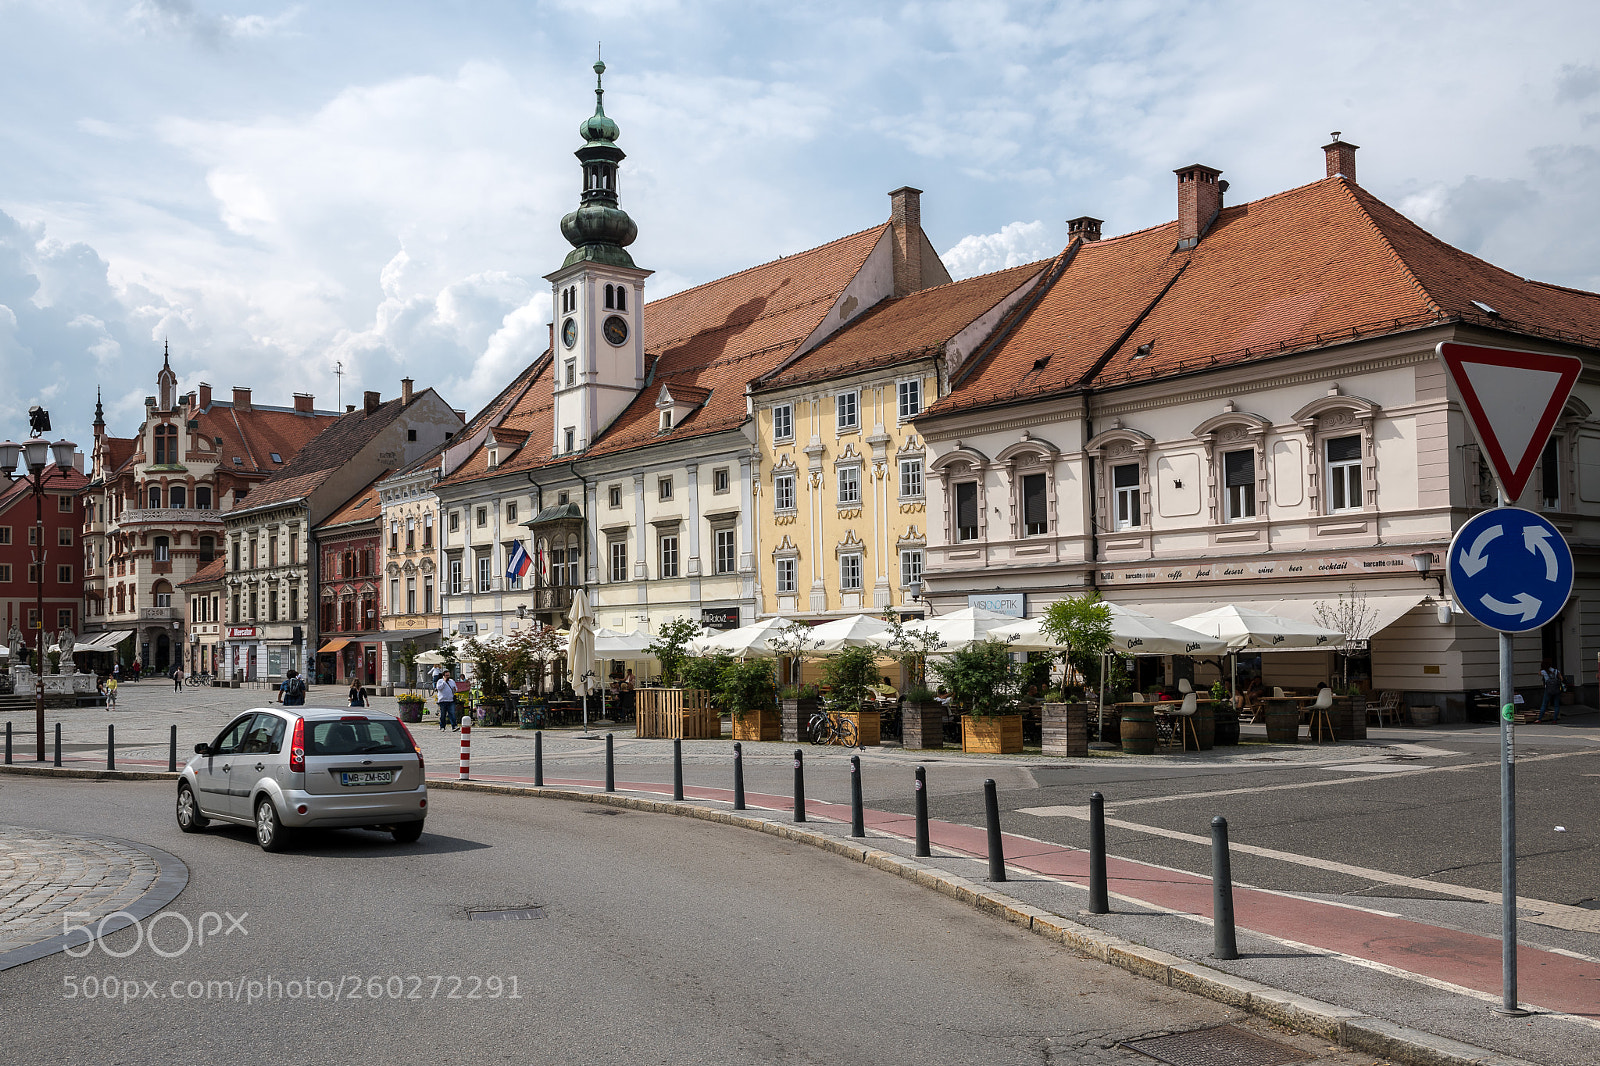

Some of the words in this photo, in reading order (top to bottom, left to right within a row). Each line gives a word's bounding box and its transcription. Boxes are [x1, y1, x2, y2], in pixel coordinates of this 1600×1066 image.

[1195, 569, 1210, 579] food
[1223, 568, 1244, 576] desert
[1258, 566, 1274, 574] wine
[1318, 561, 1348, 571] cocktail
[1127, 637, 1143, 650] Cockta
[1185, 641, 1202, 653] Cockta
[364, 772, 390, 782] ZM-630
